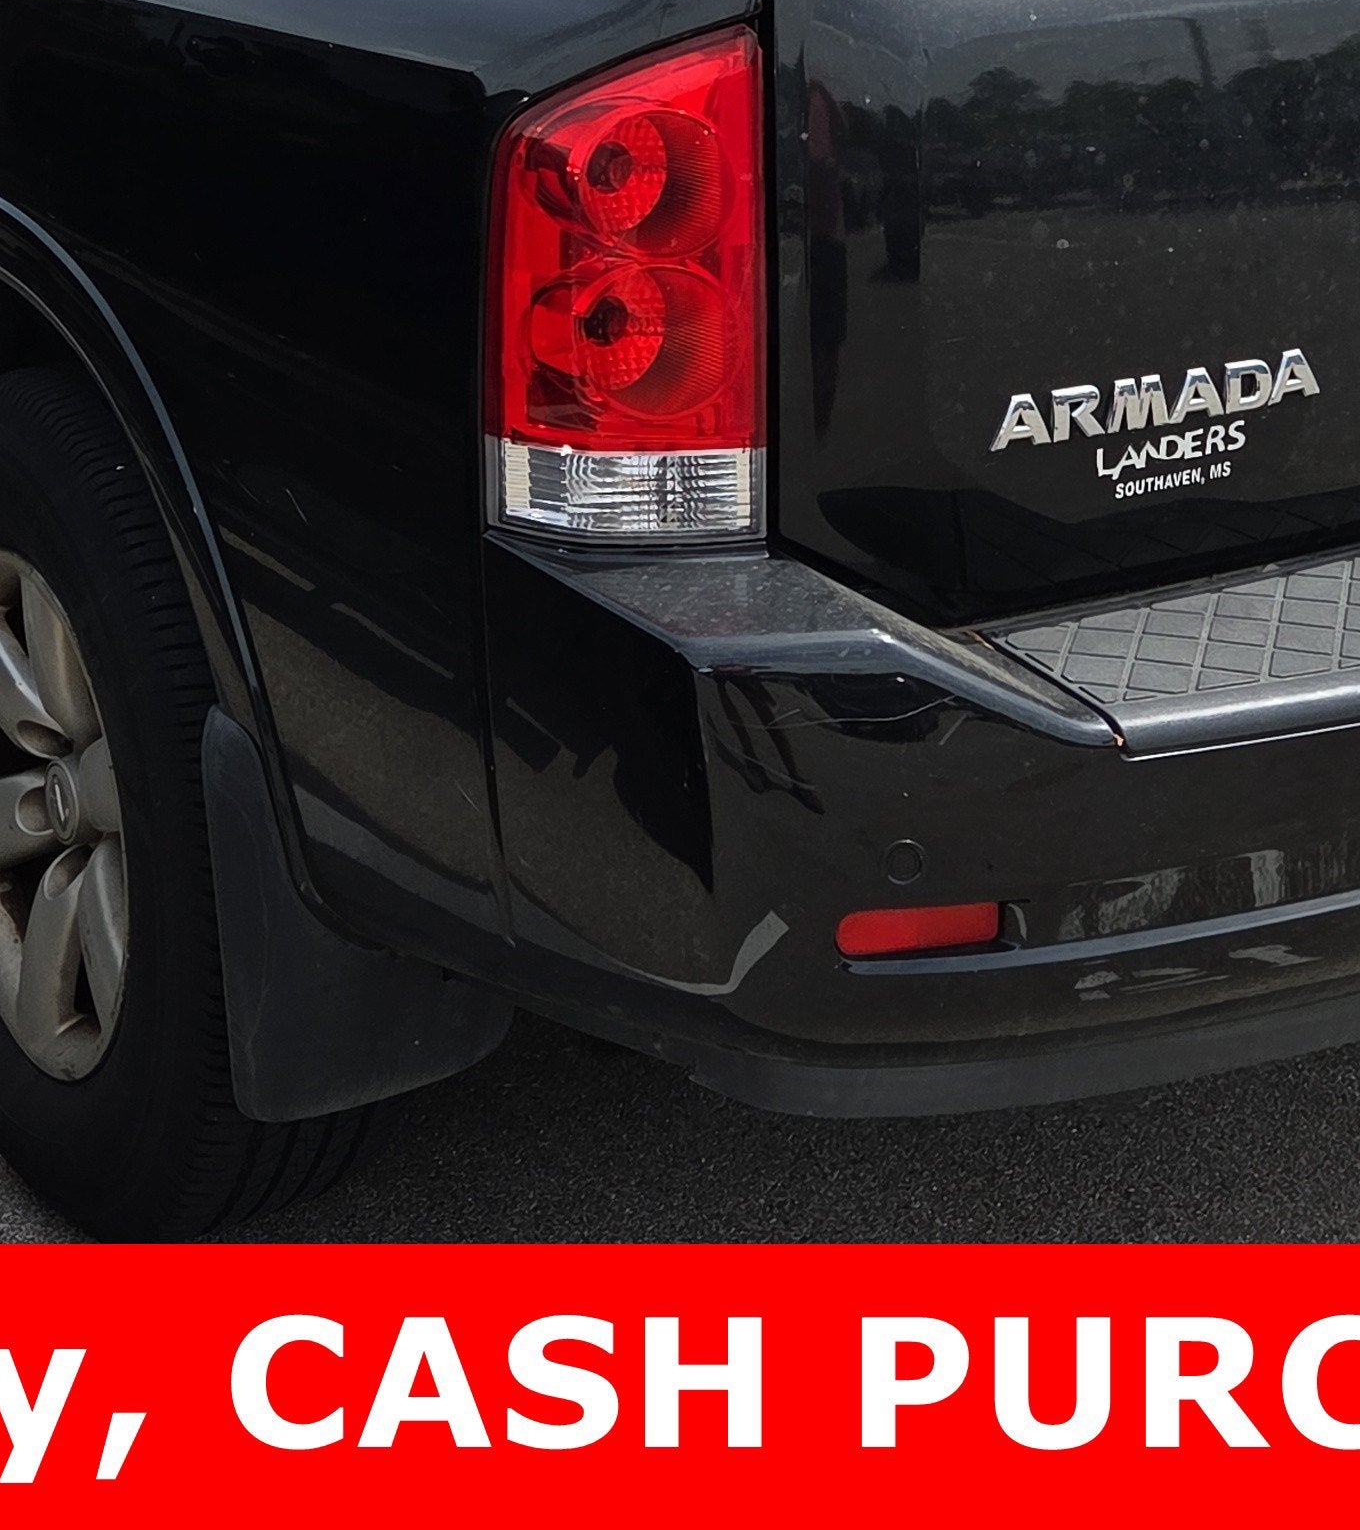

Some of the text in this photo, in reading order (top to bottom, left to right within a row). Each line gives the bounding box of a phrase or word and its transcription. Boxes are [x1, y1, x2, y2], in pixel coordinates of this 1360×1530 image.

[990, 348, 1321, 452] ARMADA
[1096, 419, 1246, 481] LANDERS
[1114, 461, 1232, 500] SOUTHAVEN, MS
